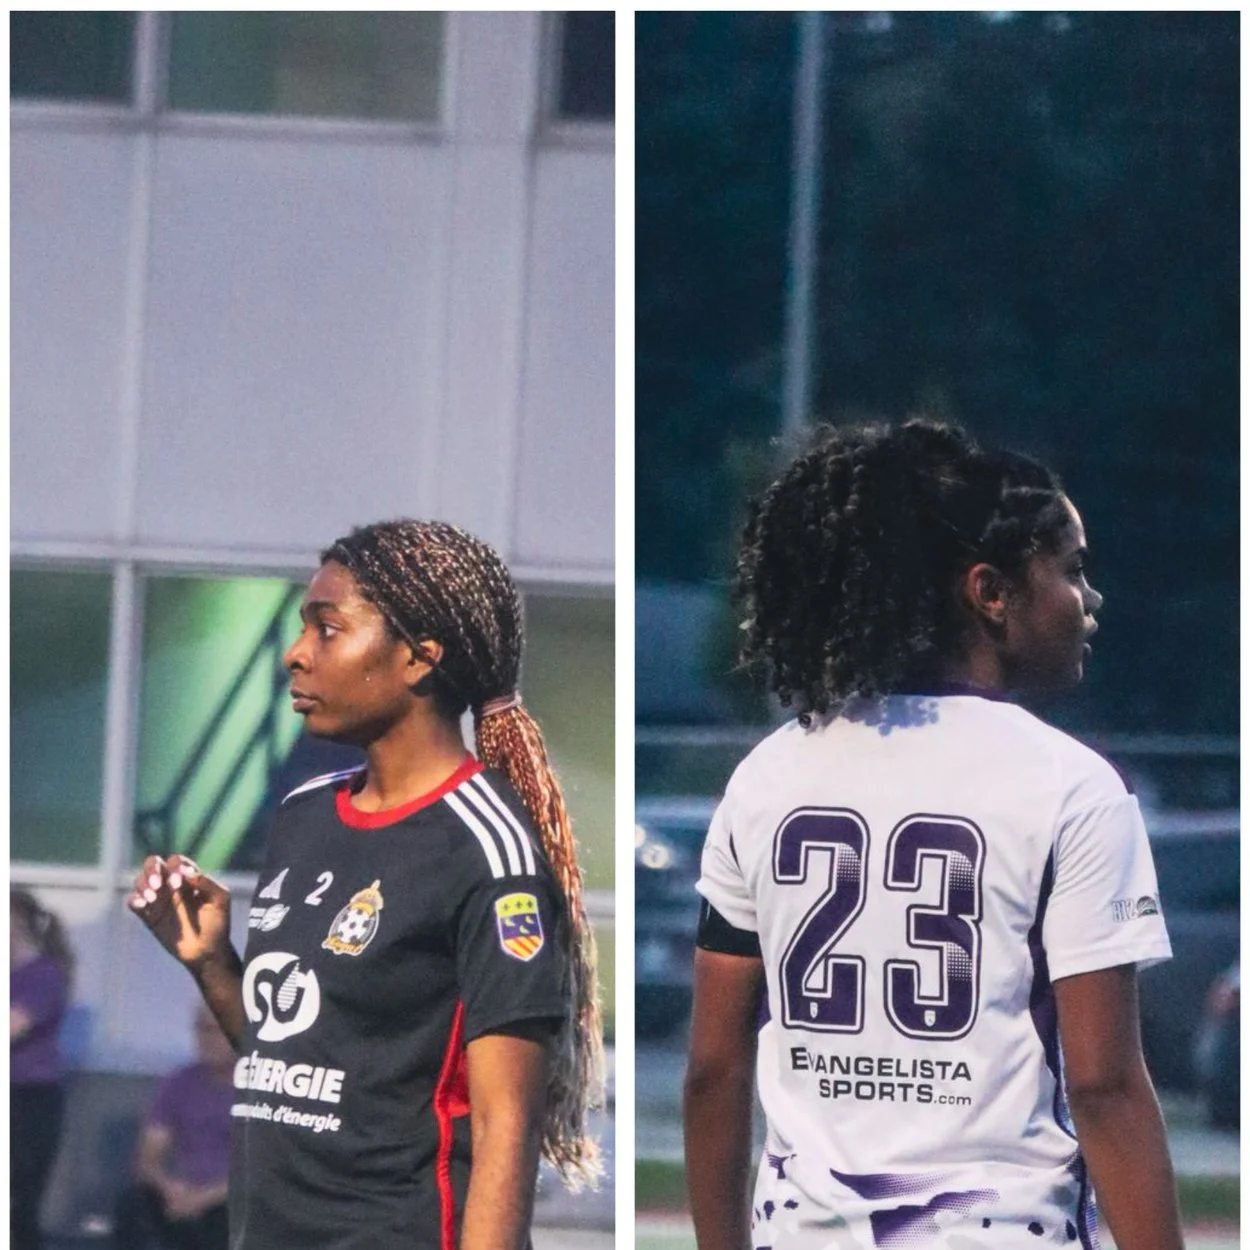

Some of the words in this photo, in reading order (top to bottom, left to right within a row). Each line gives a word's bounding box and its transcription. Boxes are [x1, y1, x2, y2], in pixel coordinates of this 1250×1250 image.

[304, 871, 334, 906] 2
[773, 806, 986, 1039] 23
[790, 1046, 972, 1081] EVANGELISTA
